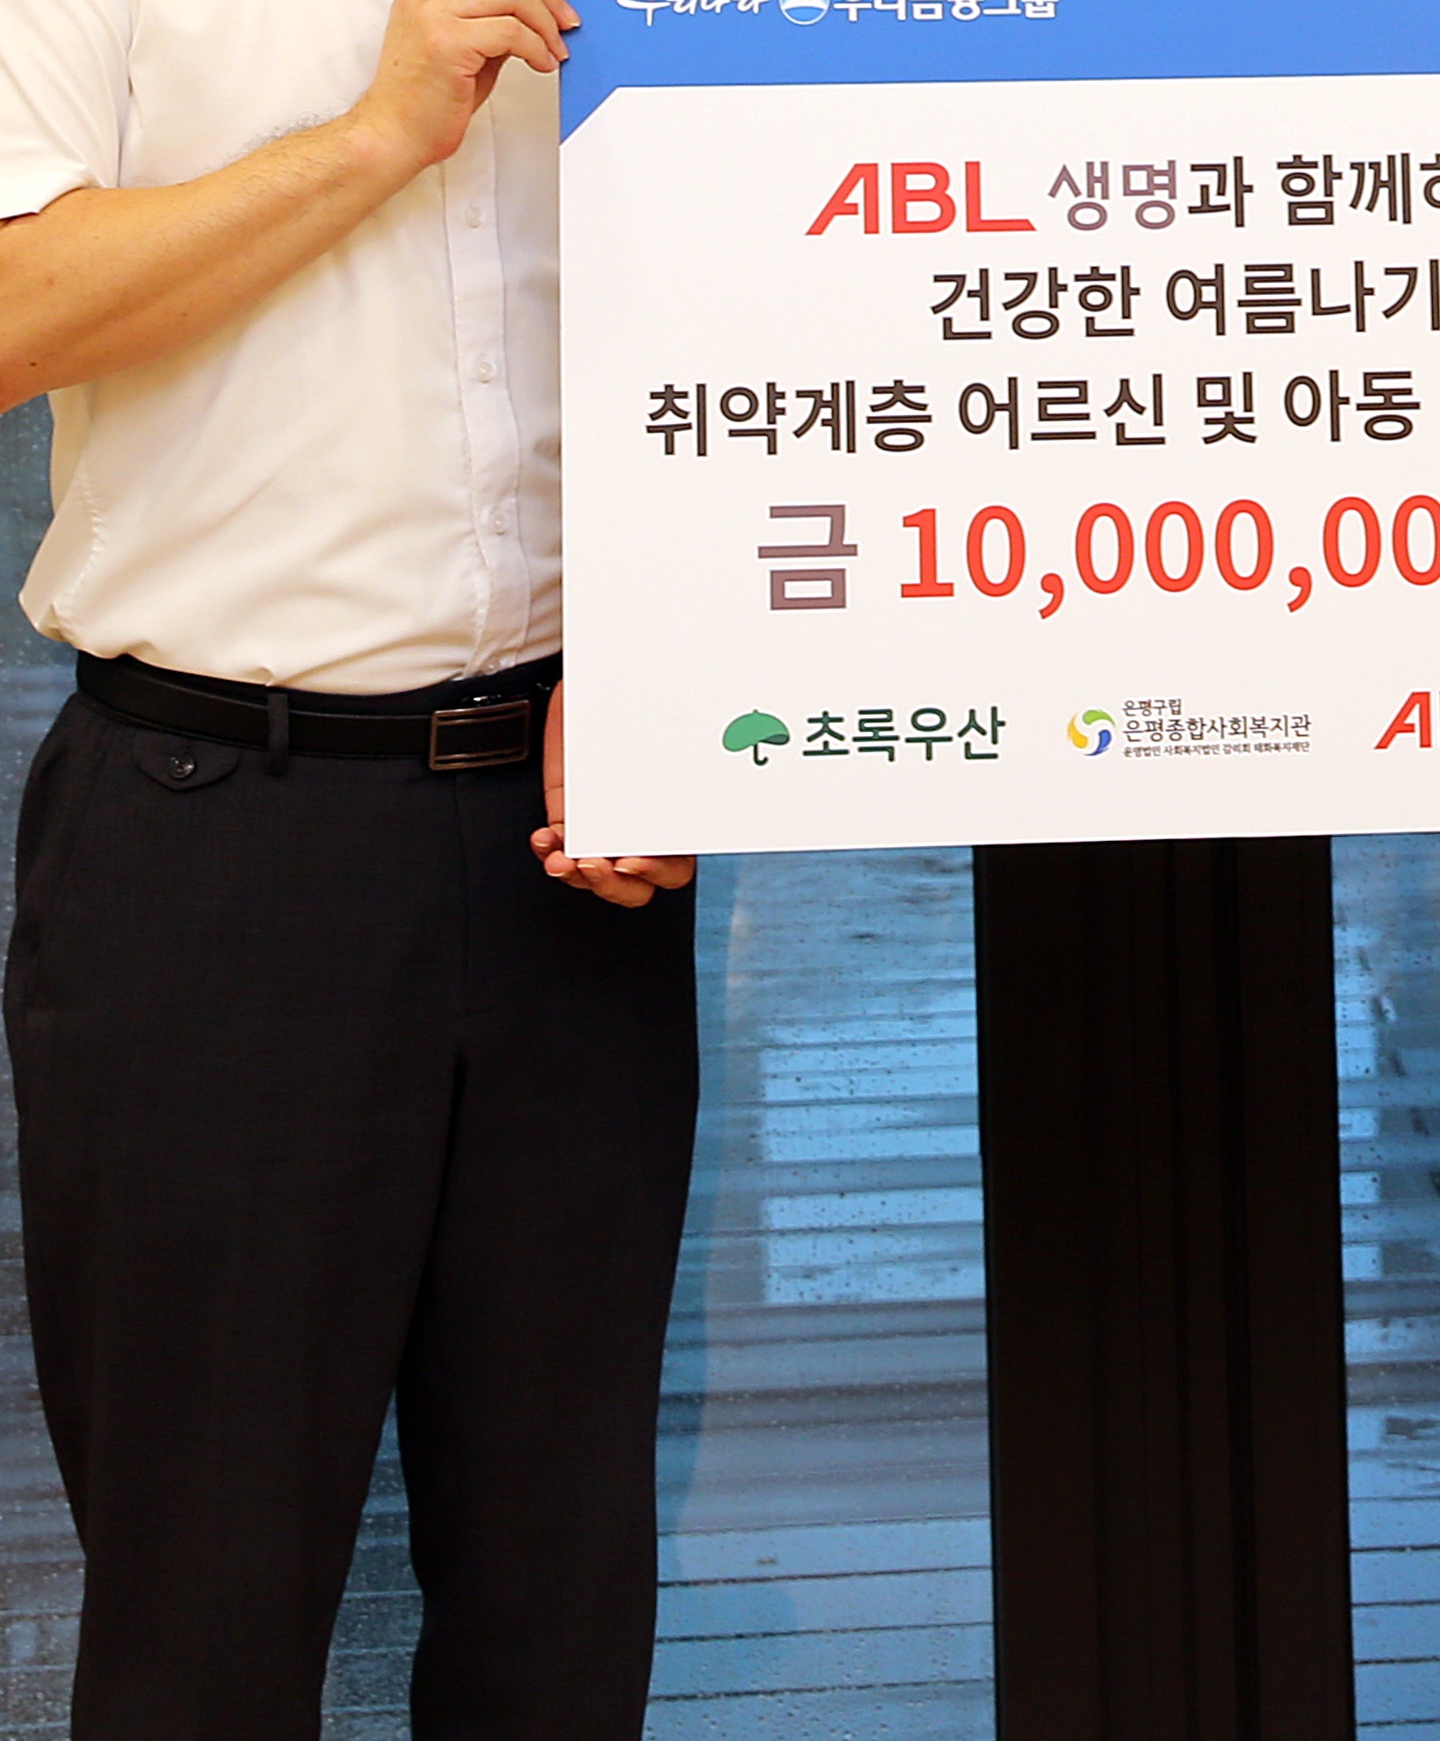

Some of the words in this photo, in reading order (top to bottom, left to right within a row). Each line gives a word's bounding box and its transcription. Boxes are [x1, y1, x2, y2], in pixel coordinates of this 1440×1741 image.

[805, 161, 1036, 235] ABL
[1049, 156, 1253, 231] 생명과
[931, 266, 1140, 340] 건강한
[1166, 259, 1440, 336] 여름나기
[646, 380, 932, 456] 취약계층
[959, 374, 1165, 450] 어르신
[1197, 372, 1256, 444] 및
[1284, 370, 1420, 442] 아동
[758, 505, 858, 610] 금
[803, 706, 1005, 762] 초록우산
[1123, 699, 1181, 716] 은평구립
[1124, 715, 1311, 742] 은평종합사회복지관
